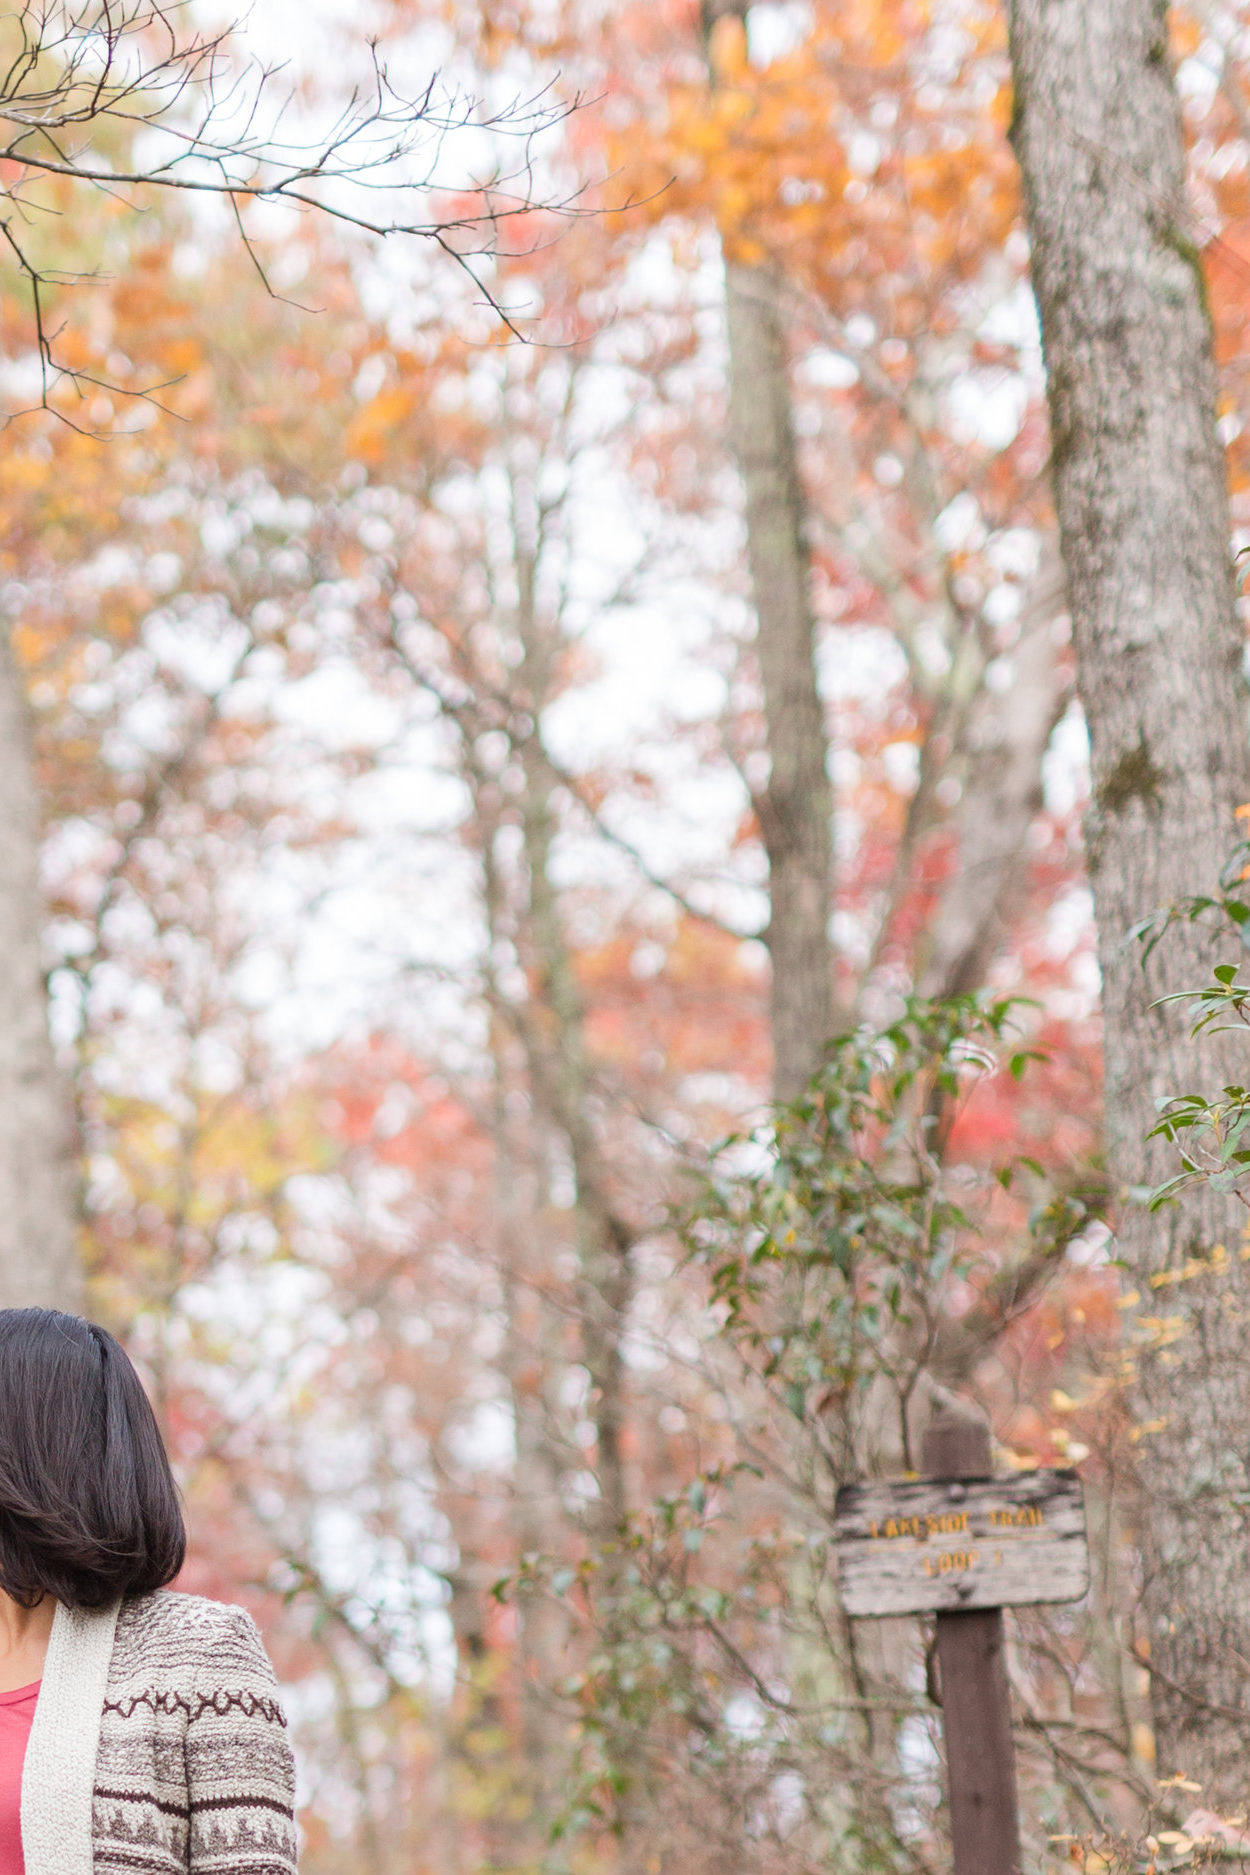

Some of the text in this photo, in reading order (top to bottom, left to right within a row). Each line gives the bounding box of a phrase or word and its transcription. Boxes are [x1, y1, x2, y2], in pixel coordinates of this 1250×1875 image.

[868, 1508, 1044, 1538] LAKESIDE TRAIL
[923, 1549, 979, 1576] LOOP
